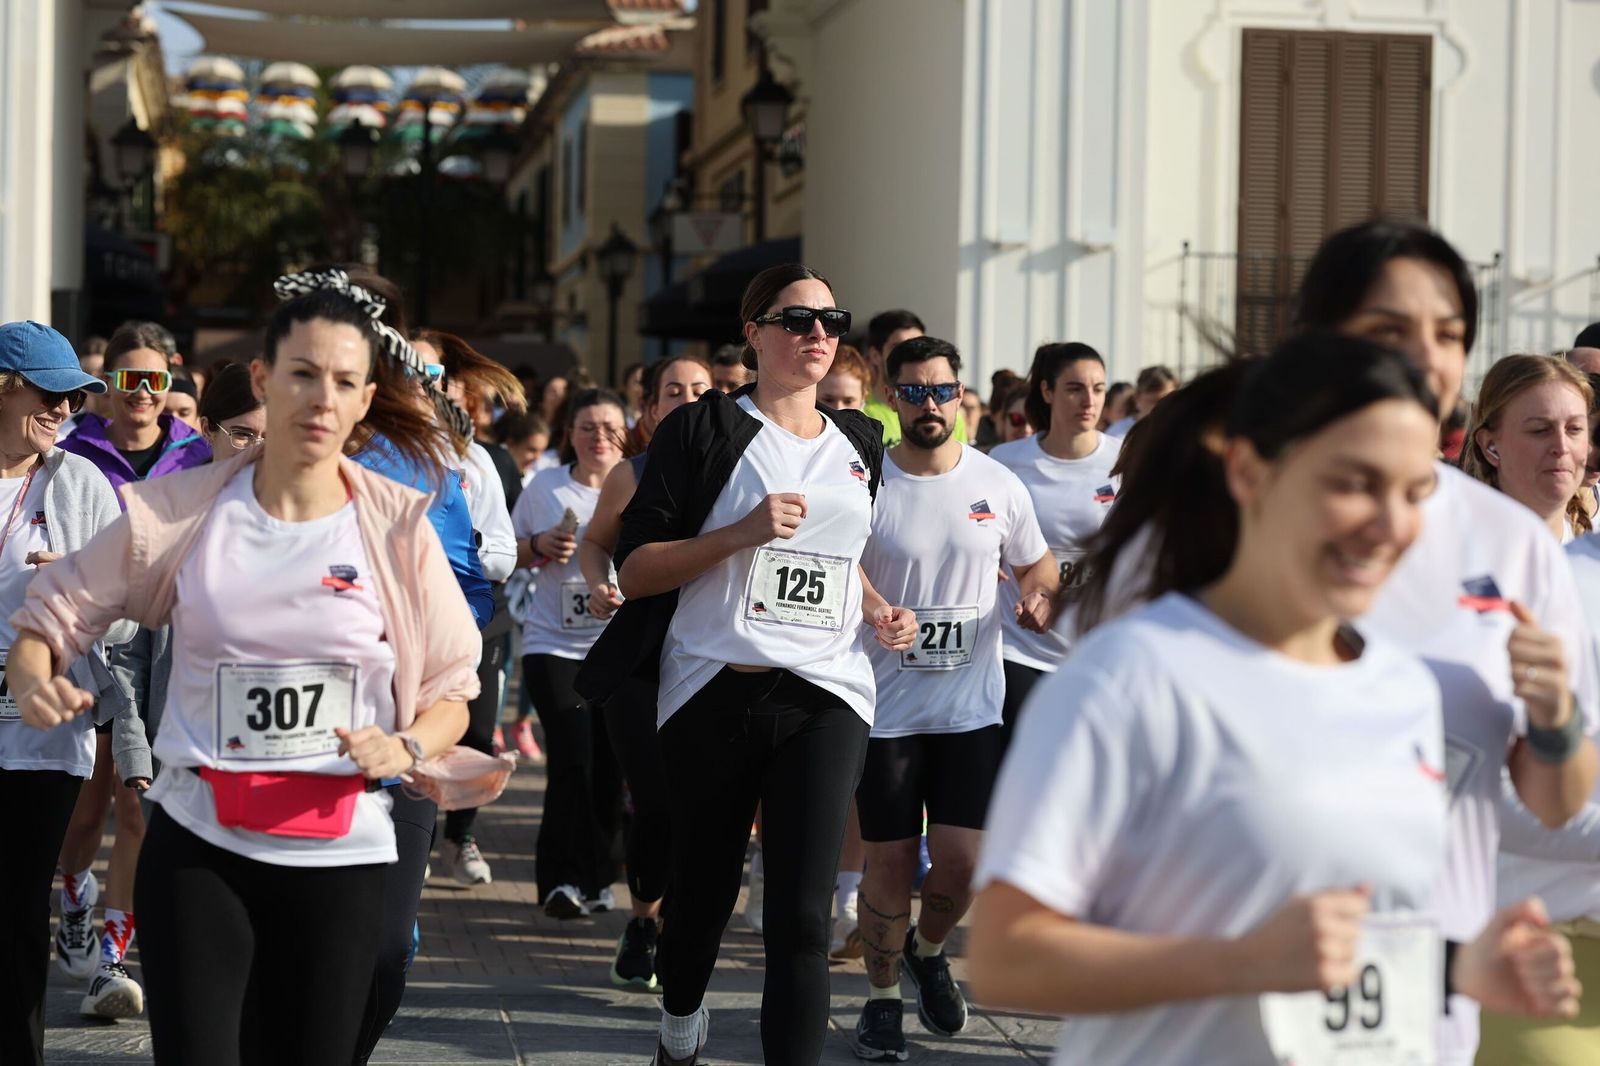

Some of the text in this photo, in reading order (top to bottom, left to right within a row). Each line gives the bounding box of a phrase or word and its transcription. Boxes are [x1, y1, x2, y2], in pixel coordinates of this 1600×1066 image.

[776, 566, 826, 605] 125
[920, 621, 962, 649] 271
[246, 683, 324, 732] 307
[1325, 964, 1383, 1032] 99
